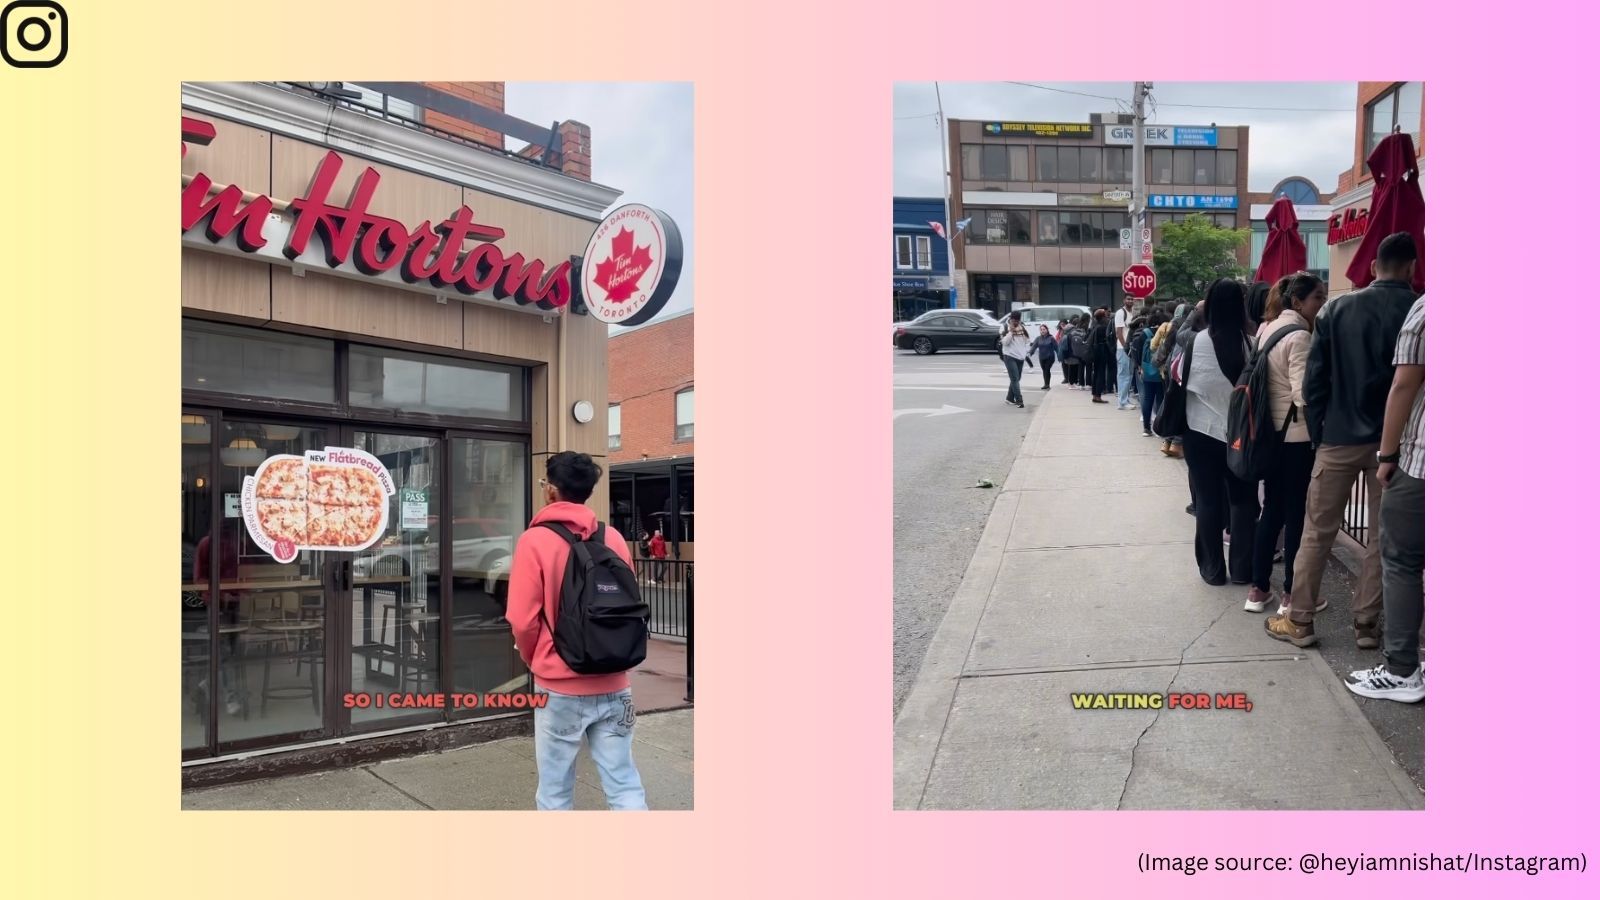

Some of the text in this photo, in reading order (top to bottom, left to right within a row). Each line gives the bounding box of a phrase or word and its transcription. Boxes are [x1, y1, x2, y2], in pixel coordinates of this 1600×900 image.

[1111, 127, 1168, 140] GREK
[1154, 194, 1195, 207] CHTO
[285, 150, 571, 309] Hortons
[597, 209, 650, 240] 426 DANFORTH
[614, 253, 632, 271] Tim
[608, 264, 643, 290] Hortons
[1124, 275, 1153, 288] STOP
[600, 294, 646, 318] TORONTO
[329, 451, 381, 474] Flatbread
[378, 472, 391, 494] Pizza
[405, 492, 425, 502] PASS
[245, 478, 273, 550] CHICKEN PARMESAN
